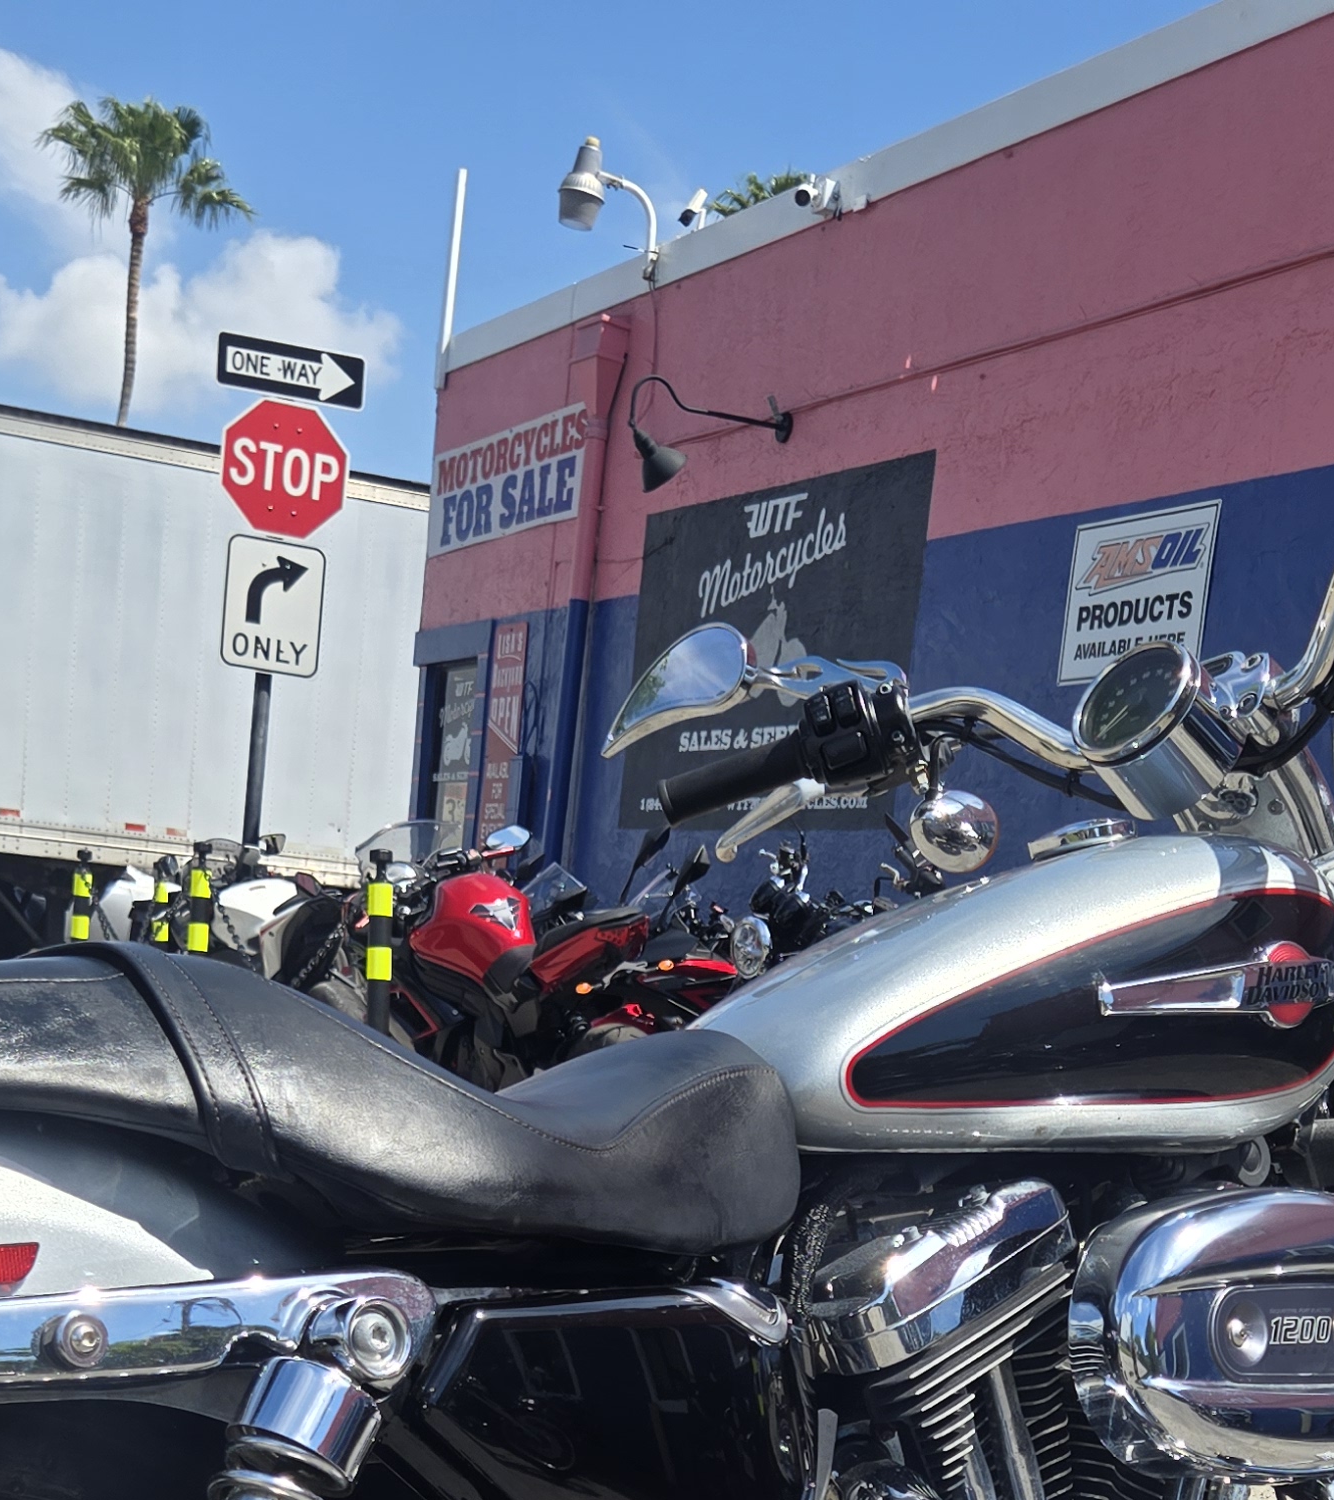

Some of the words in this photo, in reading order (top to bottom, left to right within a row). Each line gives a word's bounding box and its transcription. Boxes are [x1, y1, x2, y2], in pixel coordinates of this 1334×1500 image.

[231, 351, 270, 376] ONE
[280, 358, 322, 386] WAY
[229, 437, 339, 501] STOP
[436, 408, 589, 496] MOTORCYCLES
[440, 482, 493, 547] FOR
[499, 455, 576, 529] SALE
[744, 492, 808, 538] WTF
[698, 507, 847, 619] Motorcycles
[1083, 527, 1204, 590] AMSOIL
[1076, 590, 1193, 632] PRODUCTS
[232, 632, 308, 666] ONLY
[491, 695, 519, 741] OPEN
[678, 728, 732, 752] SALES
[733, 728, 748, 749] &
[1246, 981, 1329, 1006] DAVIDSON
[1258, 962, 1323, 986] HARLEY
[1269, 1315, 1332, 1345] 1200
